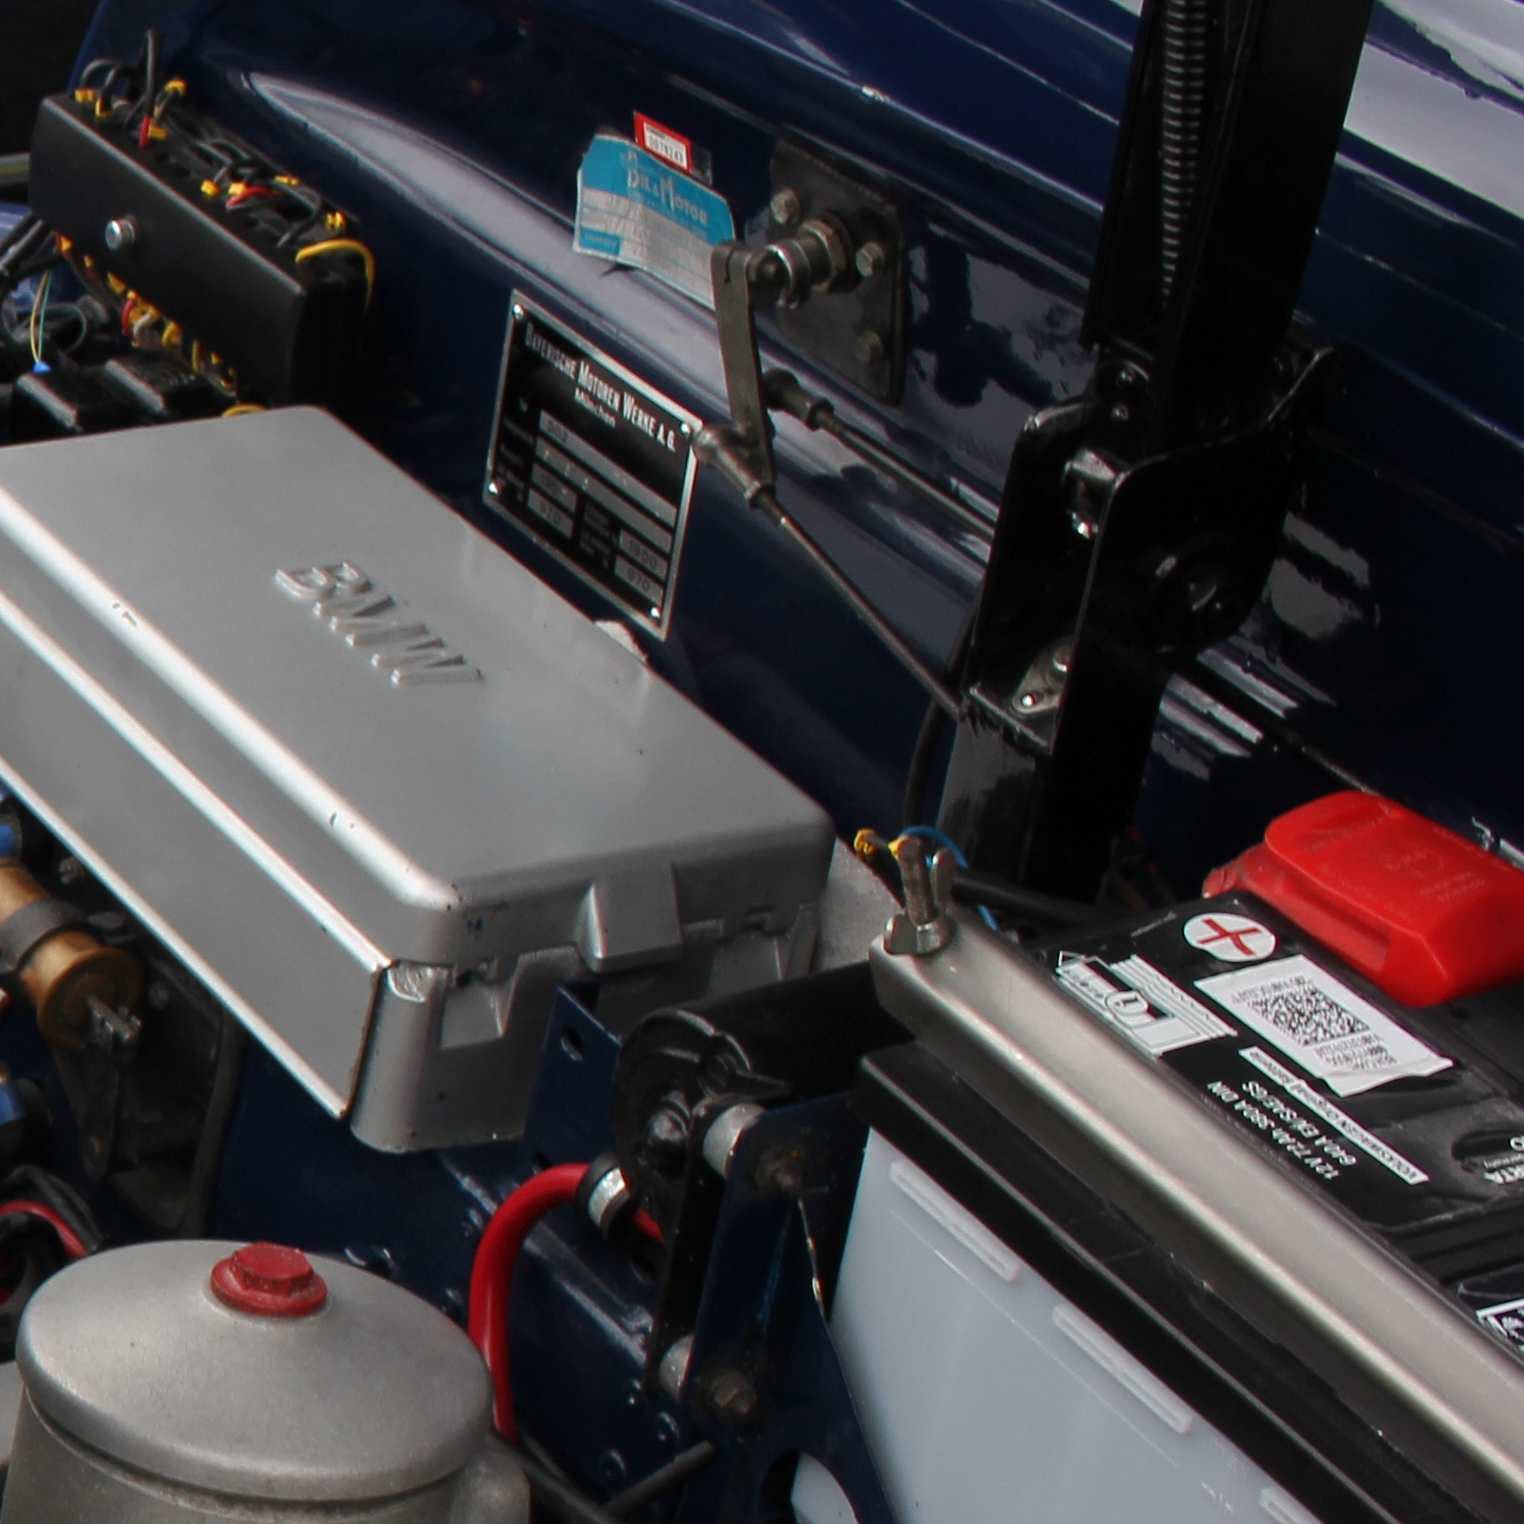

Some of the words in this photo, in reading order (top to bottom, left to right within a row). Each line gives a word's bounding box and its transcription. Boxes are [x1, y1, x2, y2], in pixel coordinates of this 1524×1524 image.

[524, 321, 578, 380] BAYERISCHE
[577, 360, 621, 412] MOTOREN
[622, 391, 657, 438] WERKE
[574, 387, 617, 429] München
[273, 560, 486, 686] BMW
